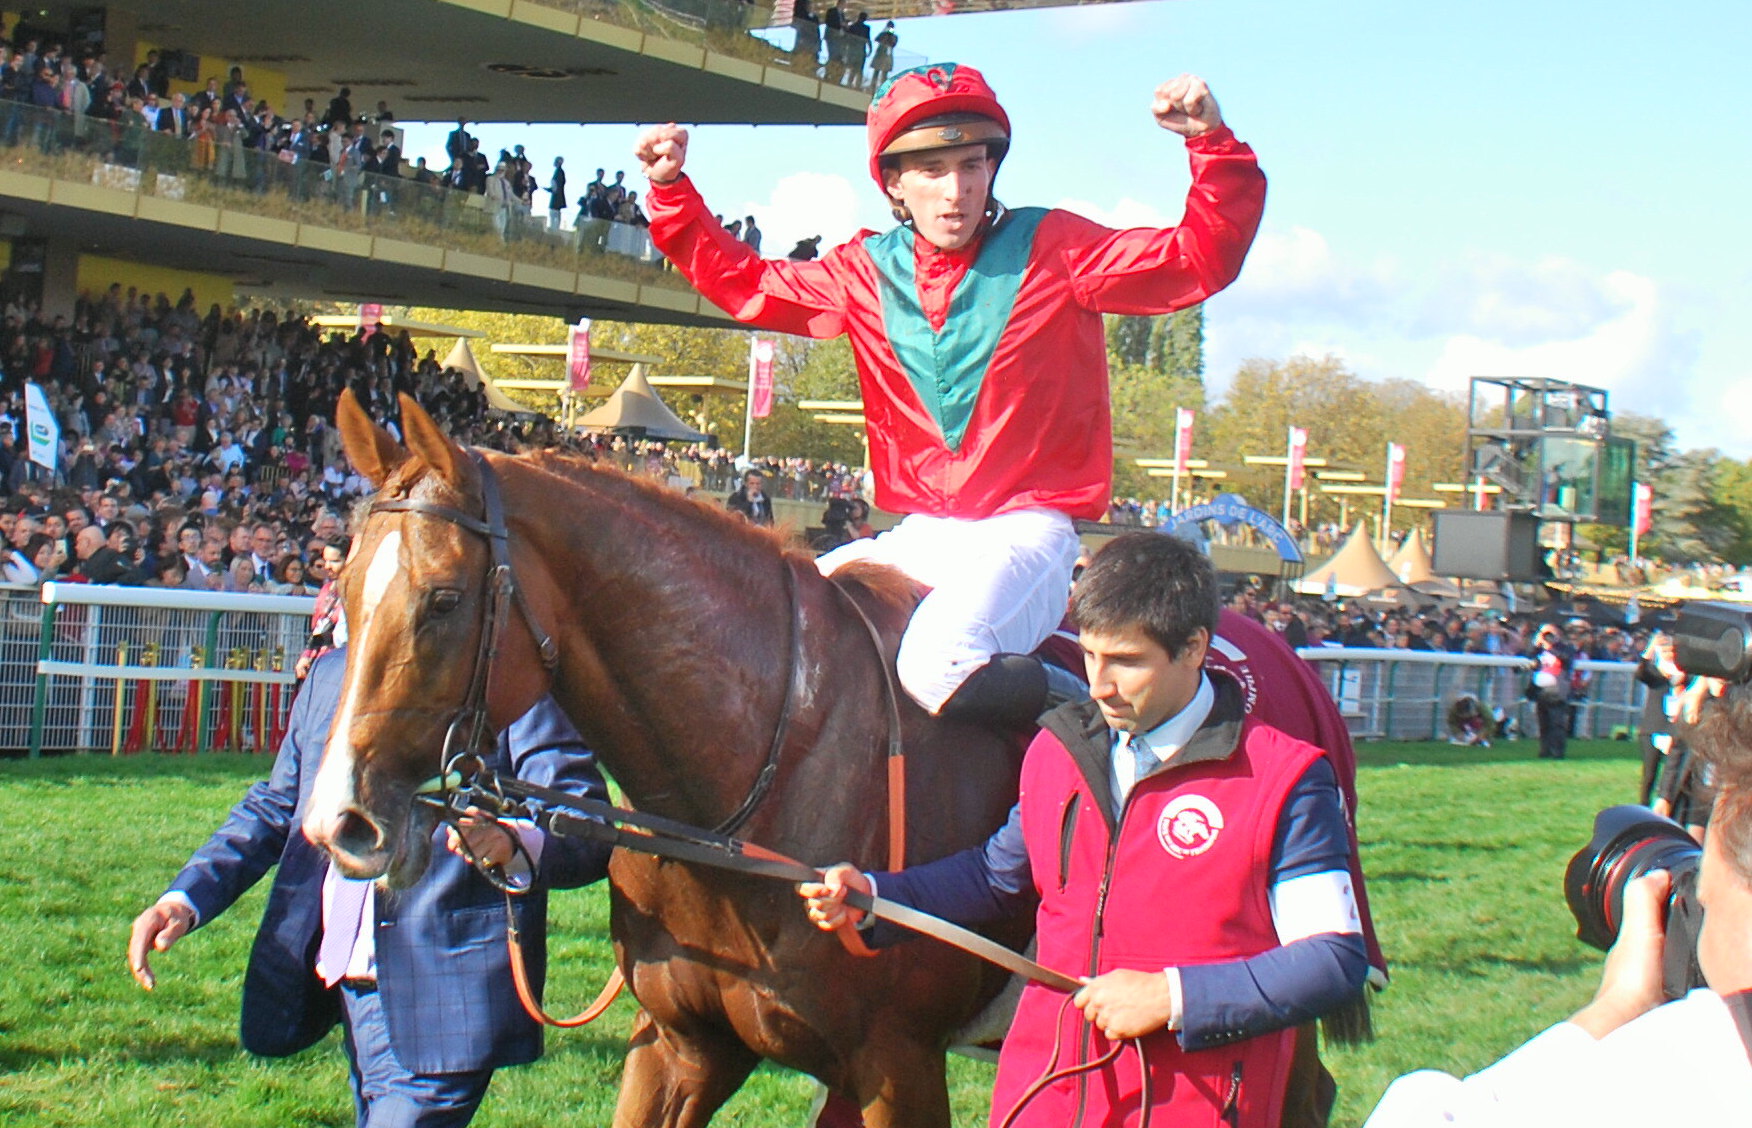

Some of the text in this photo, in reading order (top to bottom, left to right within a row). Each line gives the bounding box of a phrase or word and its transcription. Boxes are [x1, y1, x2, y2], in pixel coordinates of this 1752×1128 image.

[1171, 503, 1283, 543] JARDINS DE L'ARC
[1240, 664, 1257, 713] OMPHE
